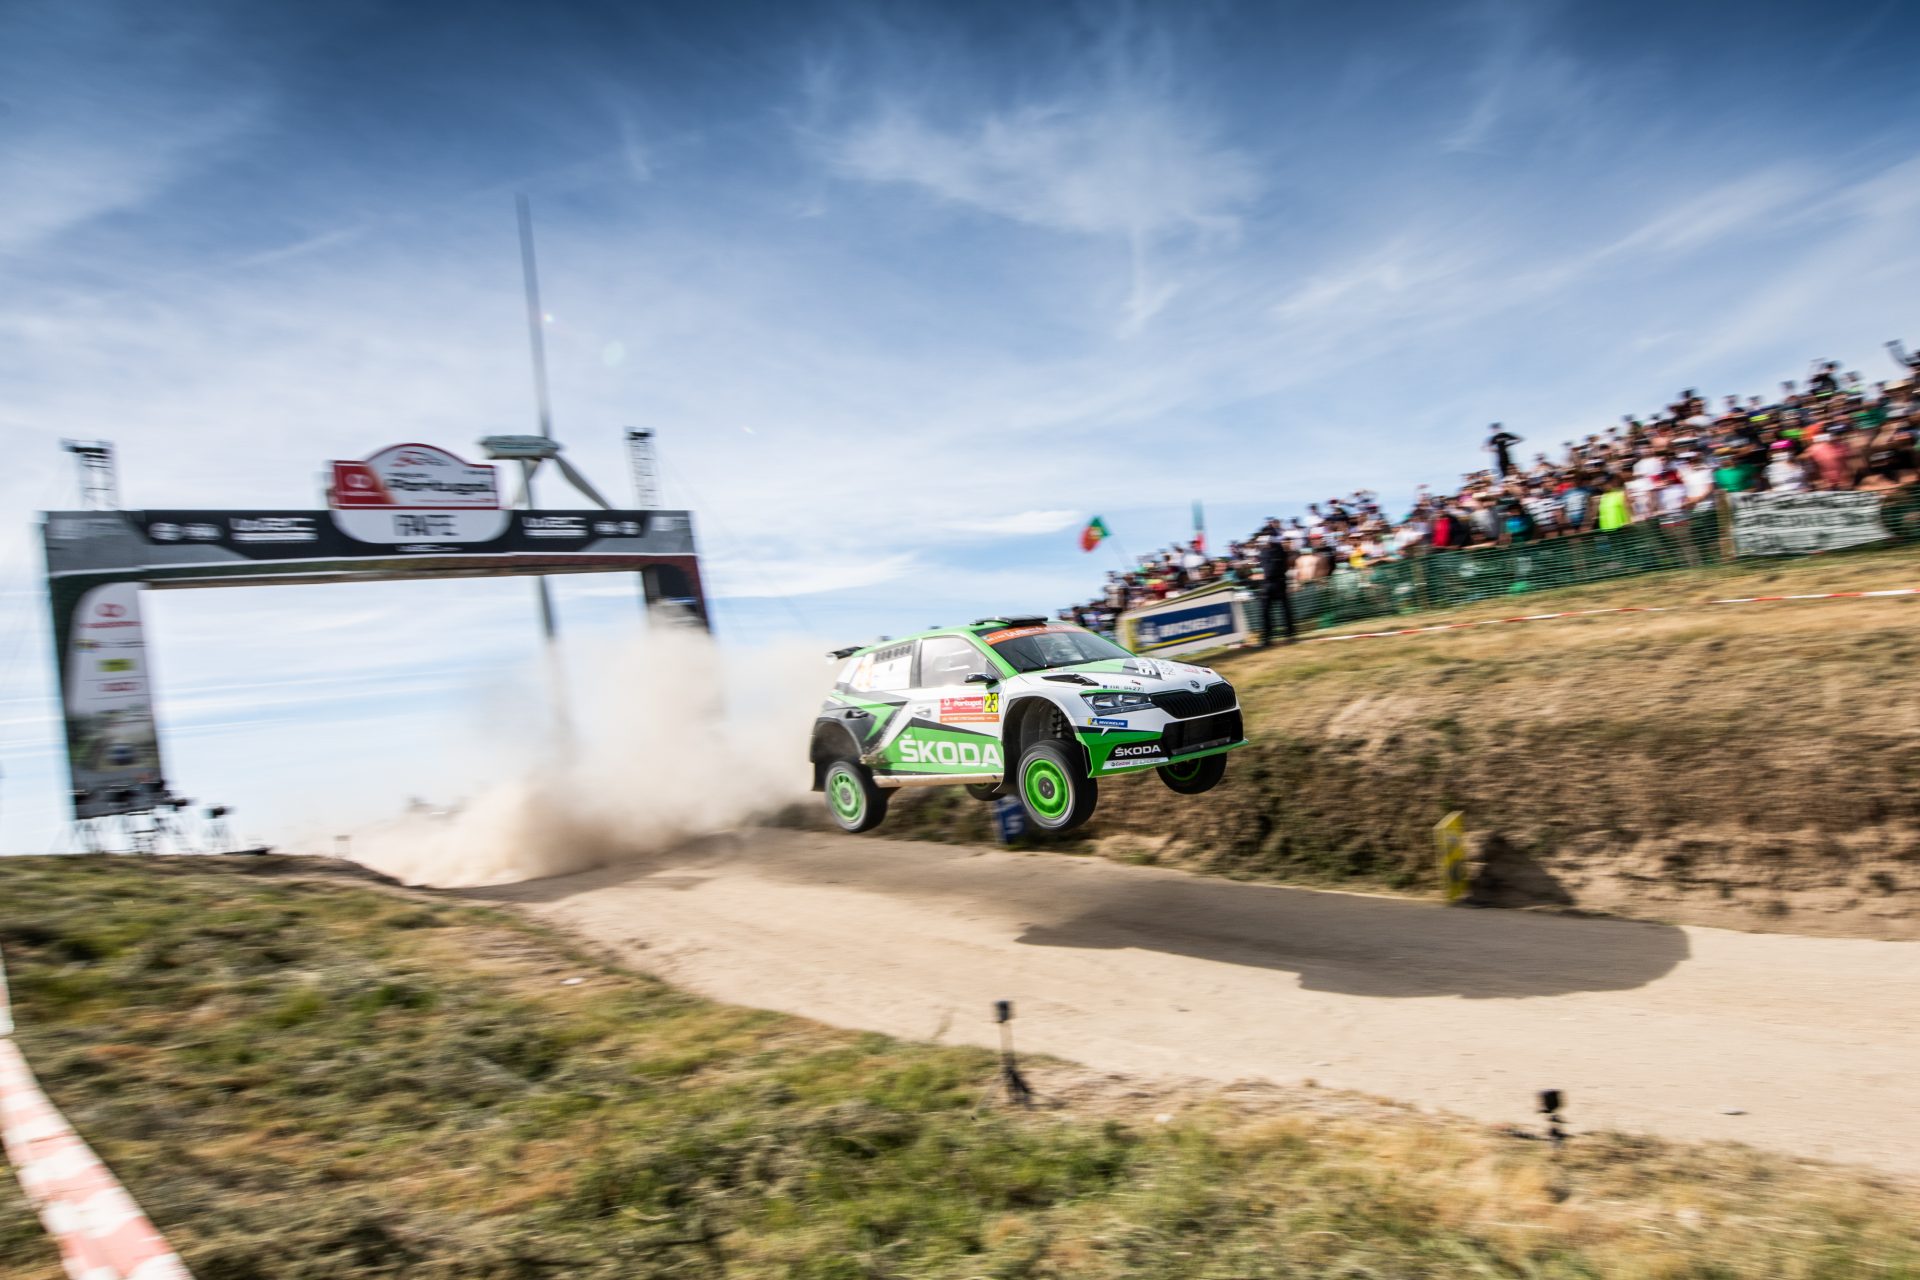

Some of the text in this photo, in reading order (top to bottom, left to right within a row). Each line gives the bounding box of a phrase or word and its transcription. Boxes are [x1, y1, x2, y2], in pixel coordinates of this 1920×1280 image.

[984, 693, 998, 712] 23
[899, 734, 1003, 768] ŠKODA
[1114, 744, 1161, 757] ŠKODA
